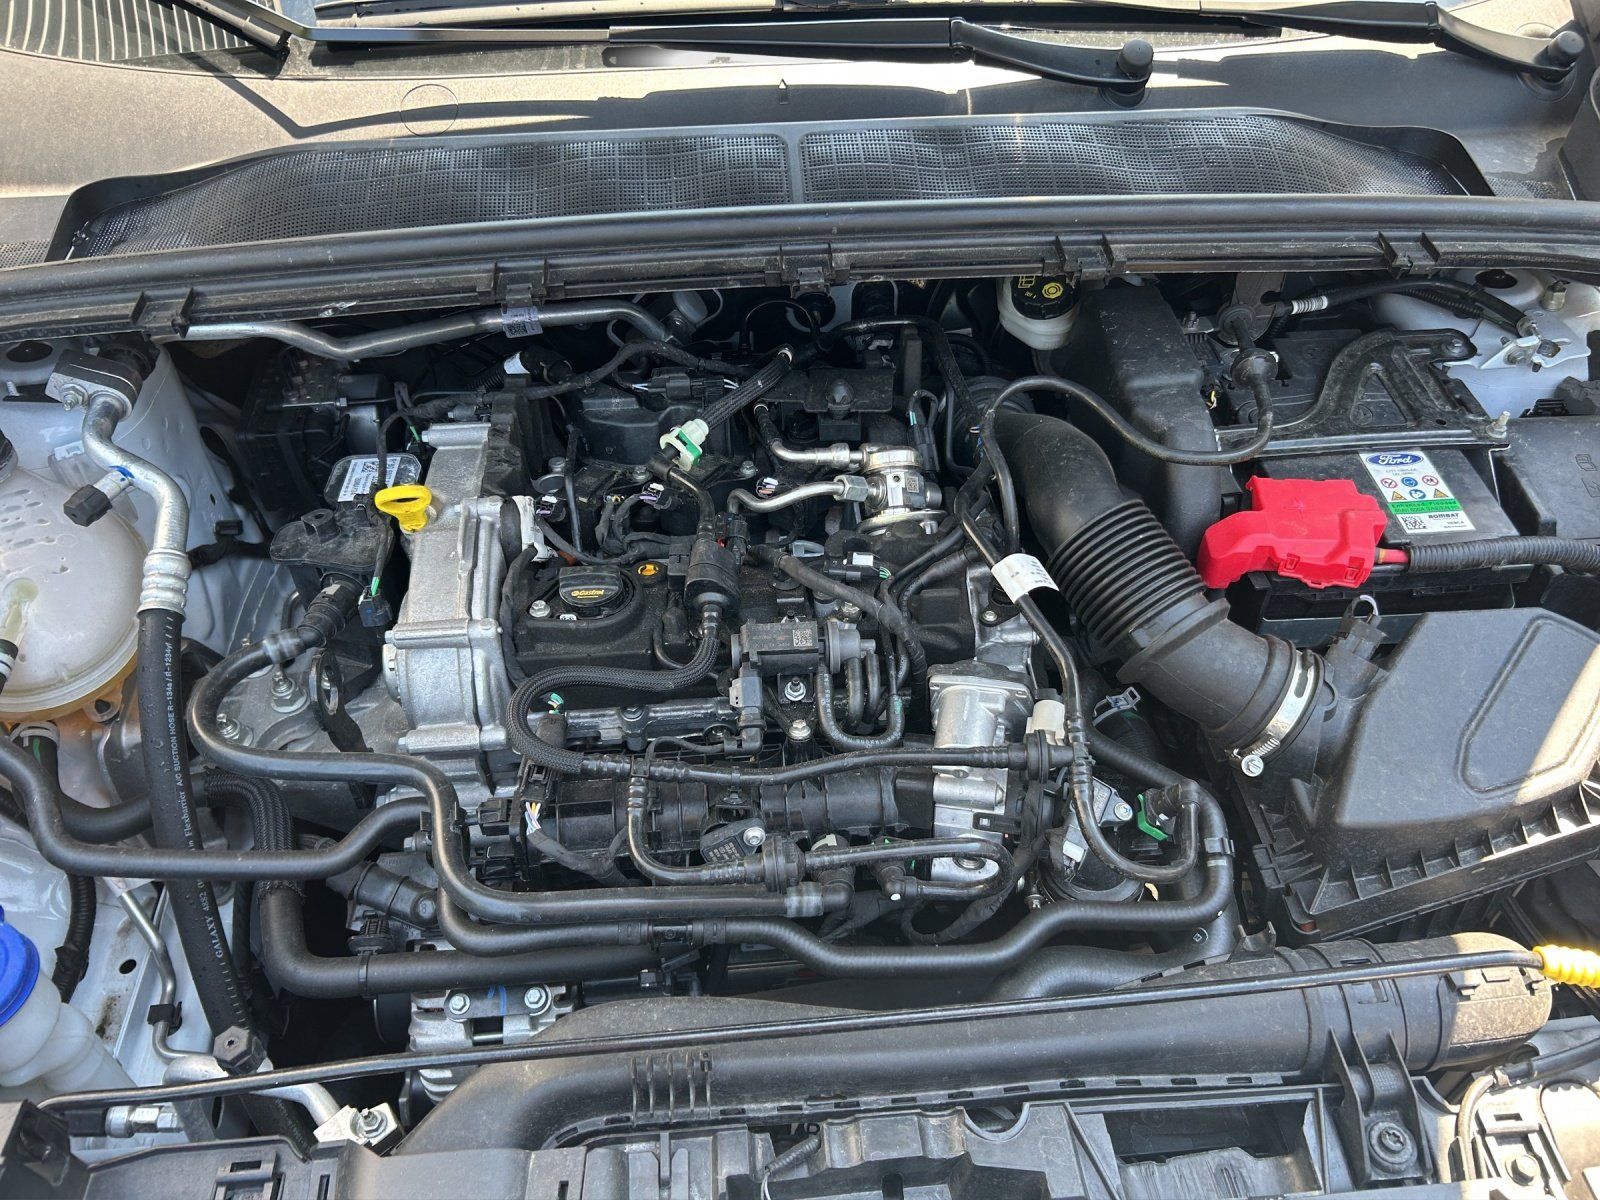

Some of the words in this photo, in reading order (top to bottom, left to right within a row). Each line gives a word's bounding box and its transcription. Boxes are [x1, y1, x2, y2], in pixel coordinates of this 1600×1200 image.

[1378, 454, 1412, 465] Ford
[579, 589, 605, 597] Castrol
[166, 682, 174, 711] R-134a
[168, 711, 177, 735] HOSE
[170, 736, 181, 771] SUCTION
[175, 773, 184, 787] A/C
[179, 791, 193, 837] Flexbarrier
[204, 915, 223, 958] GALAXY
